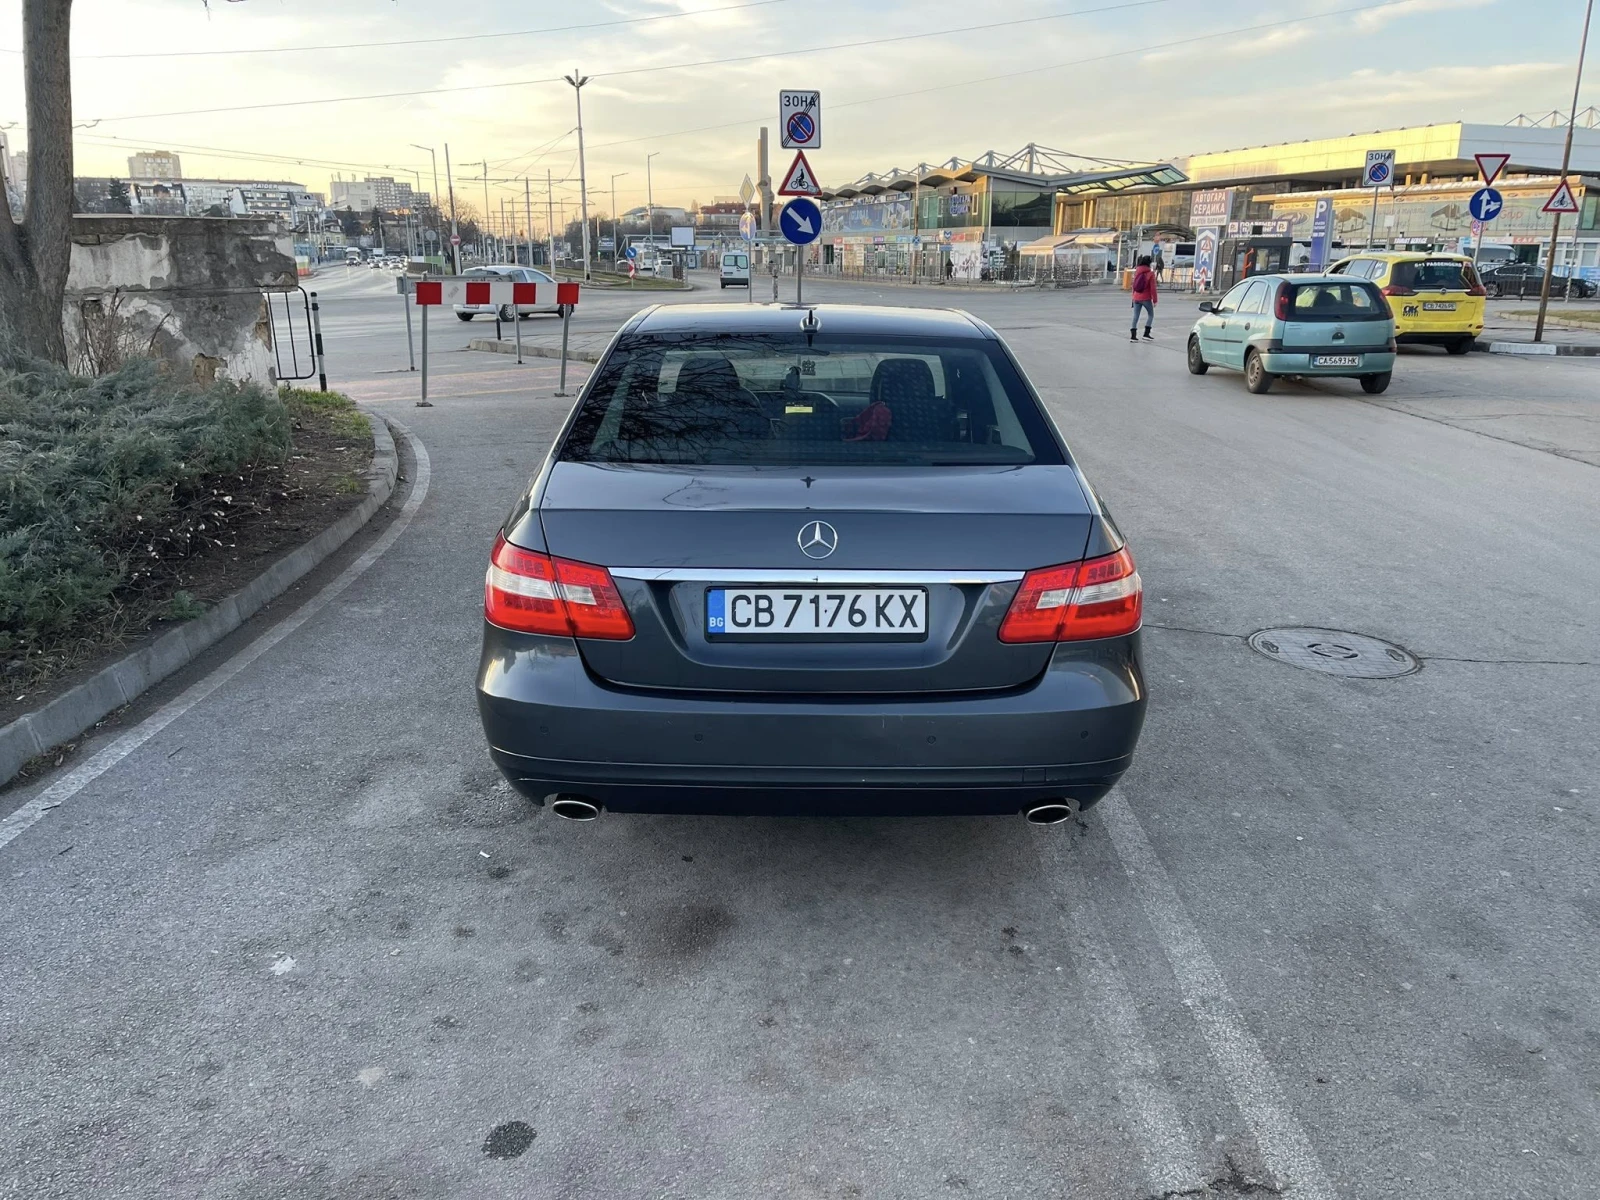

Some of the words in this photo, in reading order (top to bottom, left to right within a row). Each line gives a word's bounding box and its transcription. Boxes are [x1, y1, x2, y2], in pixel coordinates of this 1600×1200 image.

[784, 95, 816, 107] ЗОНА
[1368, 152, 1392, 161] ЗОНА
[1195, 192, 1226, 203] АВТОГАРА
[1193, 203, 1225, 216] СЕРДИКА
[709, 617, 724, 627] BG
